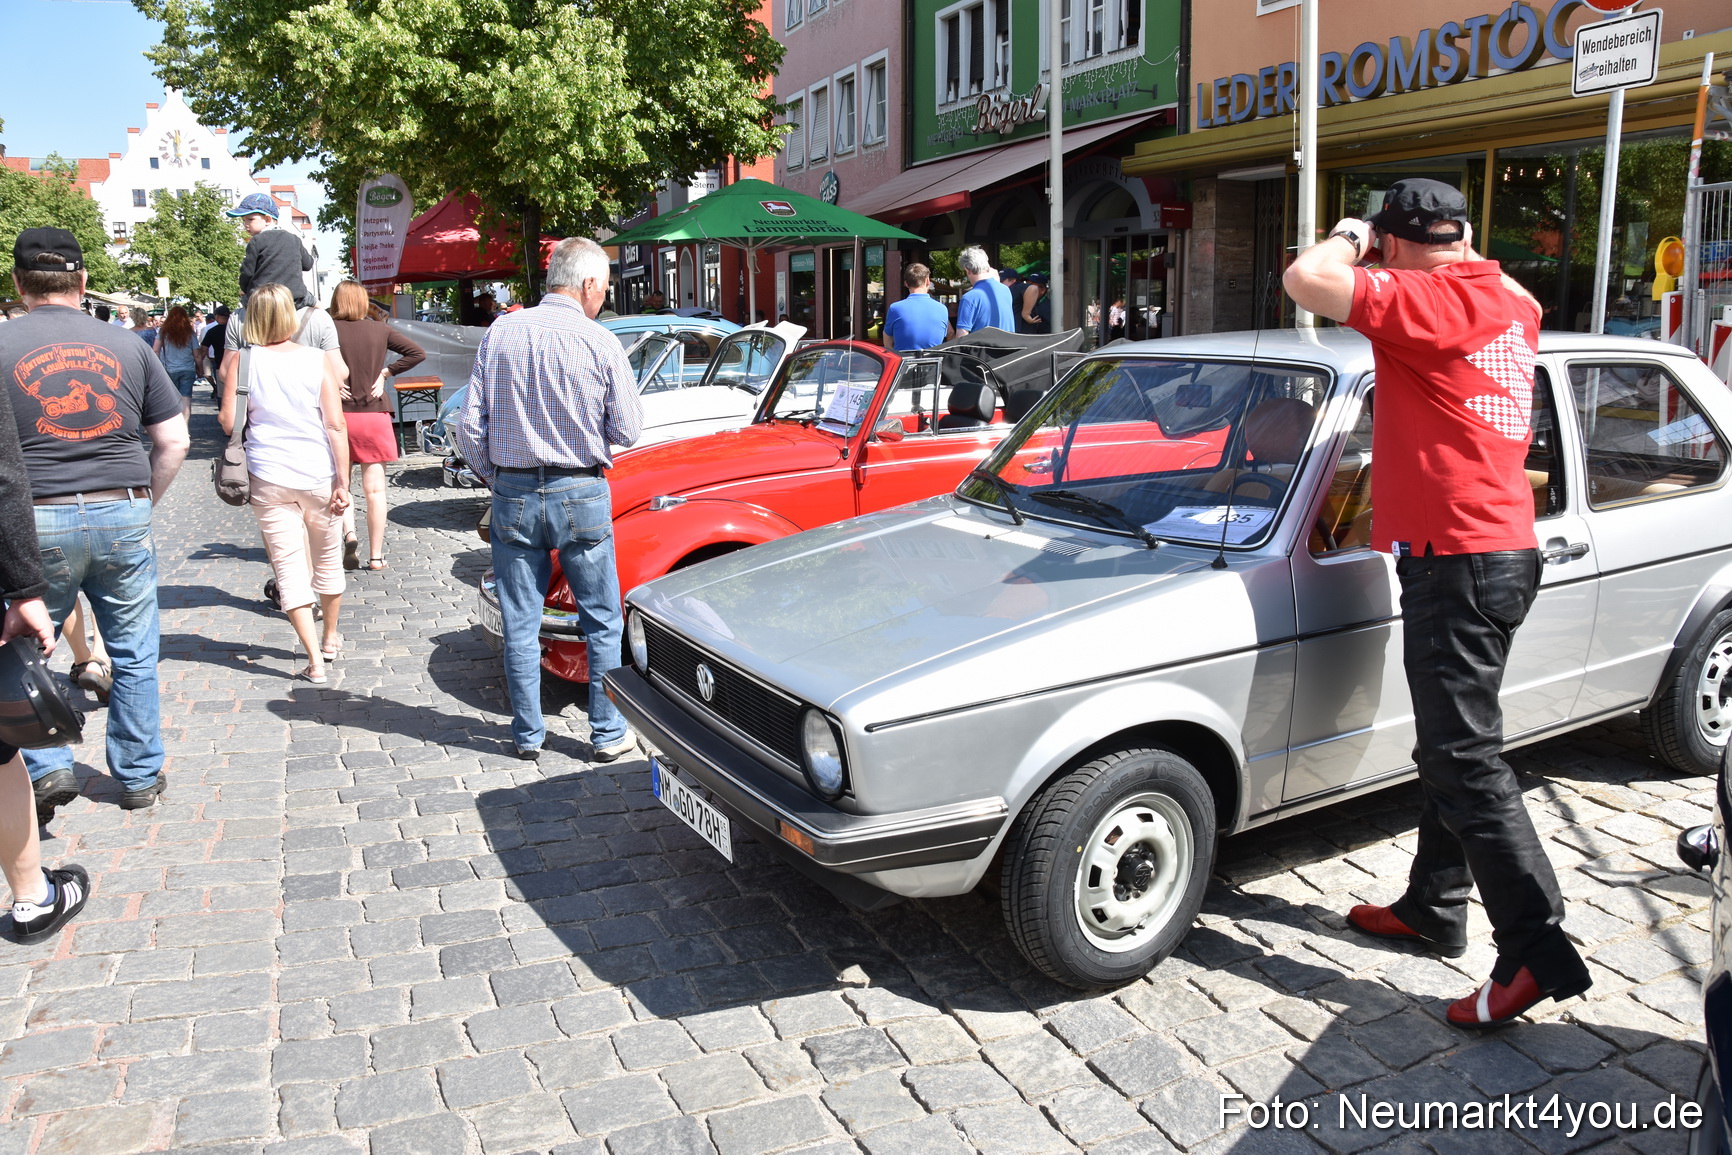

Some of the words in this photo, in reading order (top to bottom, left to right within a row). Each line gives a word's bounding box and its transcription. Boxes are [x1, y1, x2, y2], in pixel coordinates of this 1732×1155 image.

[1581, 26, 1652, 55] Wendebereich
[1196, 62, 1299, 128] LEDER
[1318, 0, 1619, 106] ROMSTÖC
[1592, 57, 1637, 77] eihalten
[972, 83, 1046, 134] Bögerl
[694, 181, 715, 189] Stern
[743, 224, 849, 233] Lammsbräu
[18, 351, 54, 380] KENTUCKY
[52, 346, 87, 363] KUSTOM
[849, 393, 864, 406] 145
[46, 424, 80, 439] CUSTOM
[81, 421, 113, 439] PAINTING
[1216, 513, 1255, 524] 135
